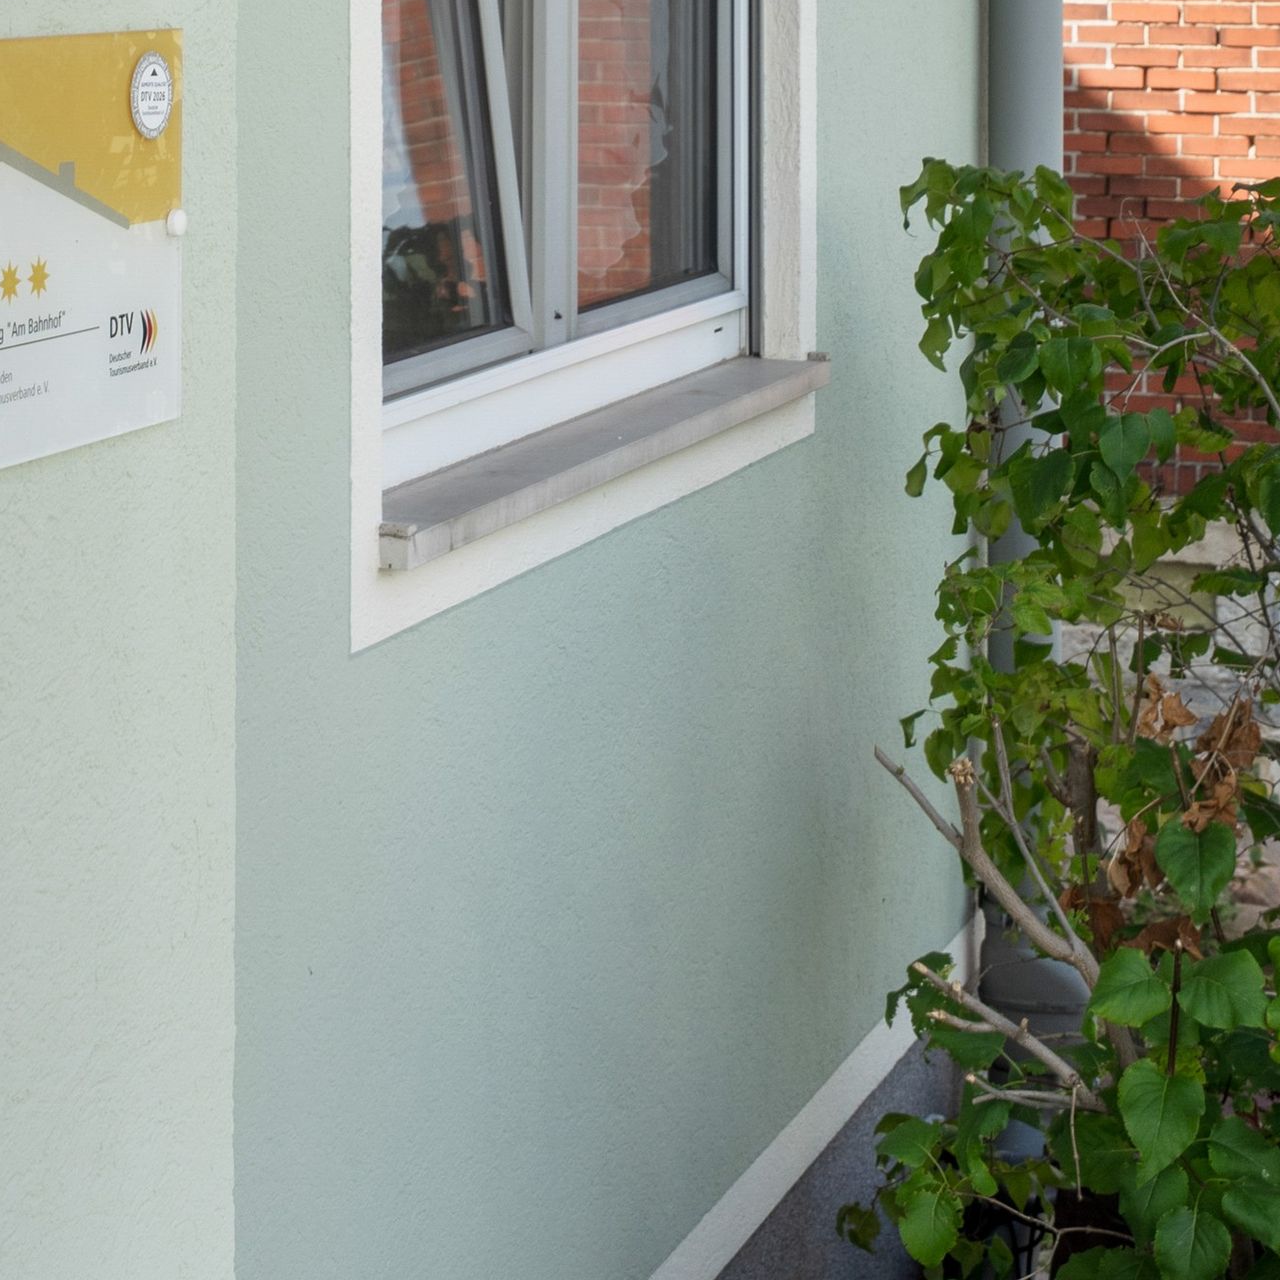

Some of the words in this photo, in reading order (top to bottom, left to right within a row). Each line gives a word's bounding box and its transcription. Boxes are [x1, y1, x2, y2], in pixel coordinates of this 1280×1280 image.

[141, 91, 152, 102] DTV
[109, 311, 134, 338] DTV
[109, 350, 132, 364] Deutscher
[109, 358, 149, 377] Tourismusverband
[0, 370, 13, 385] den
